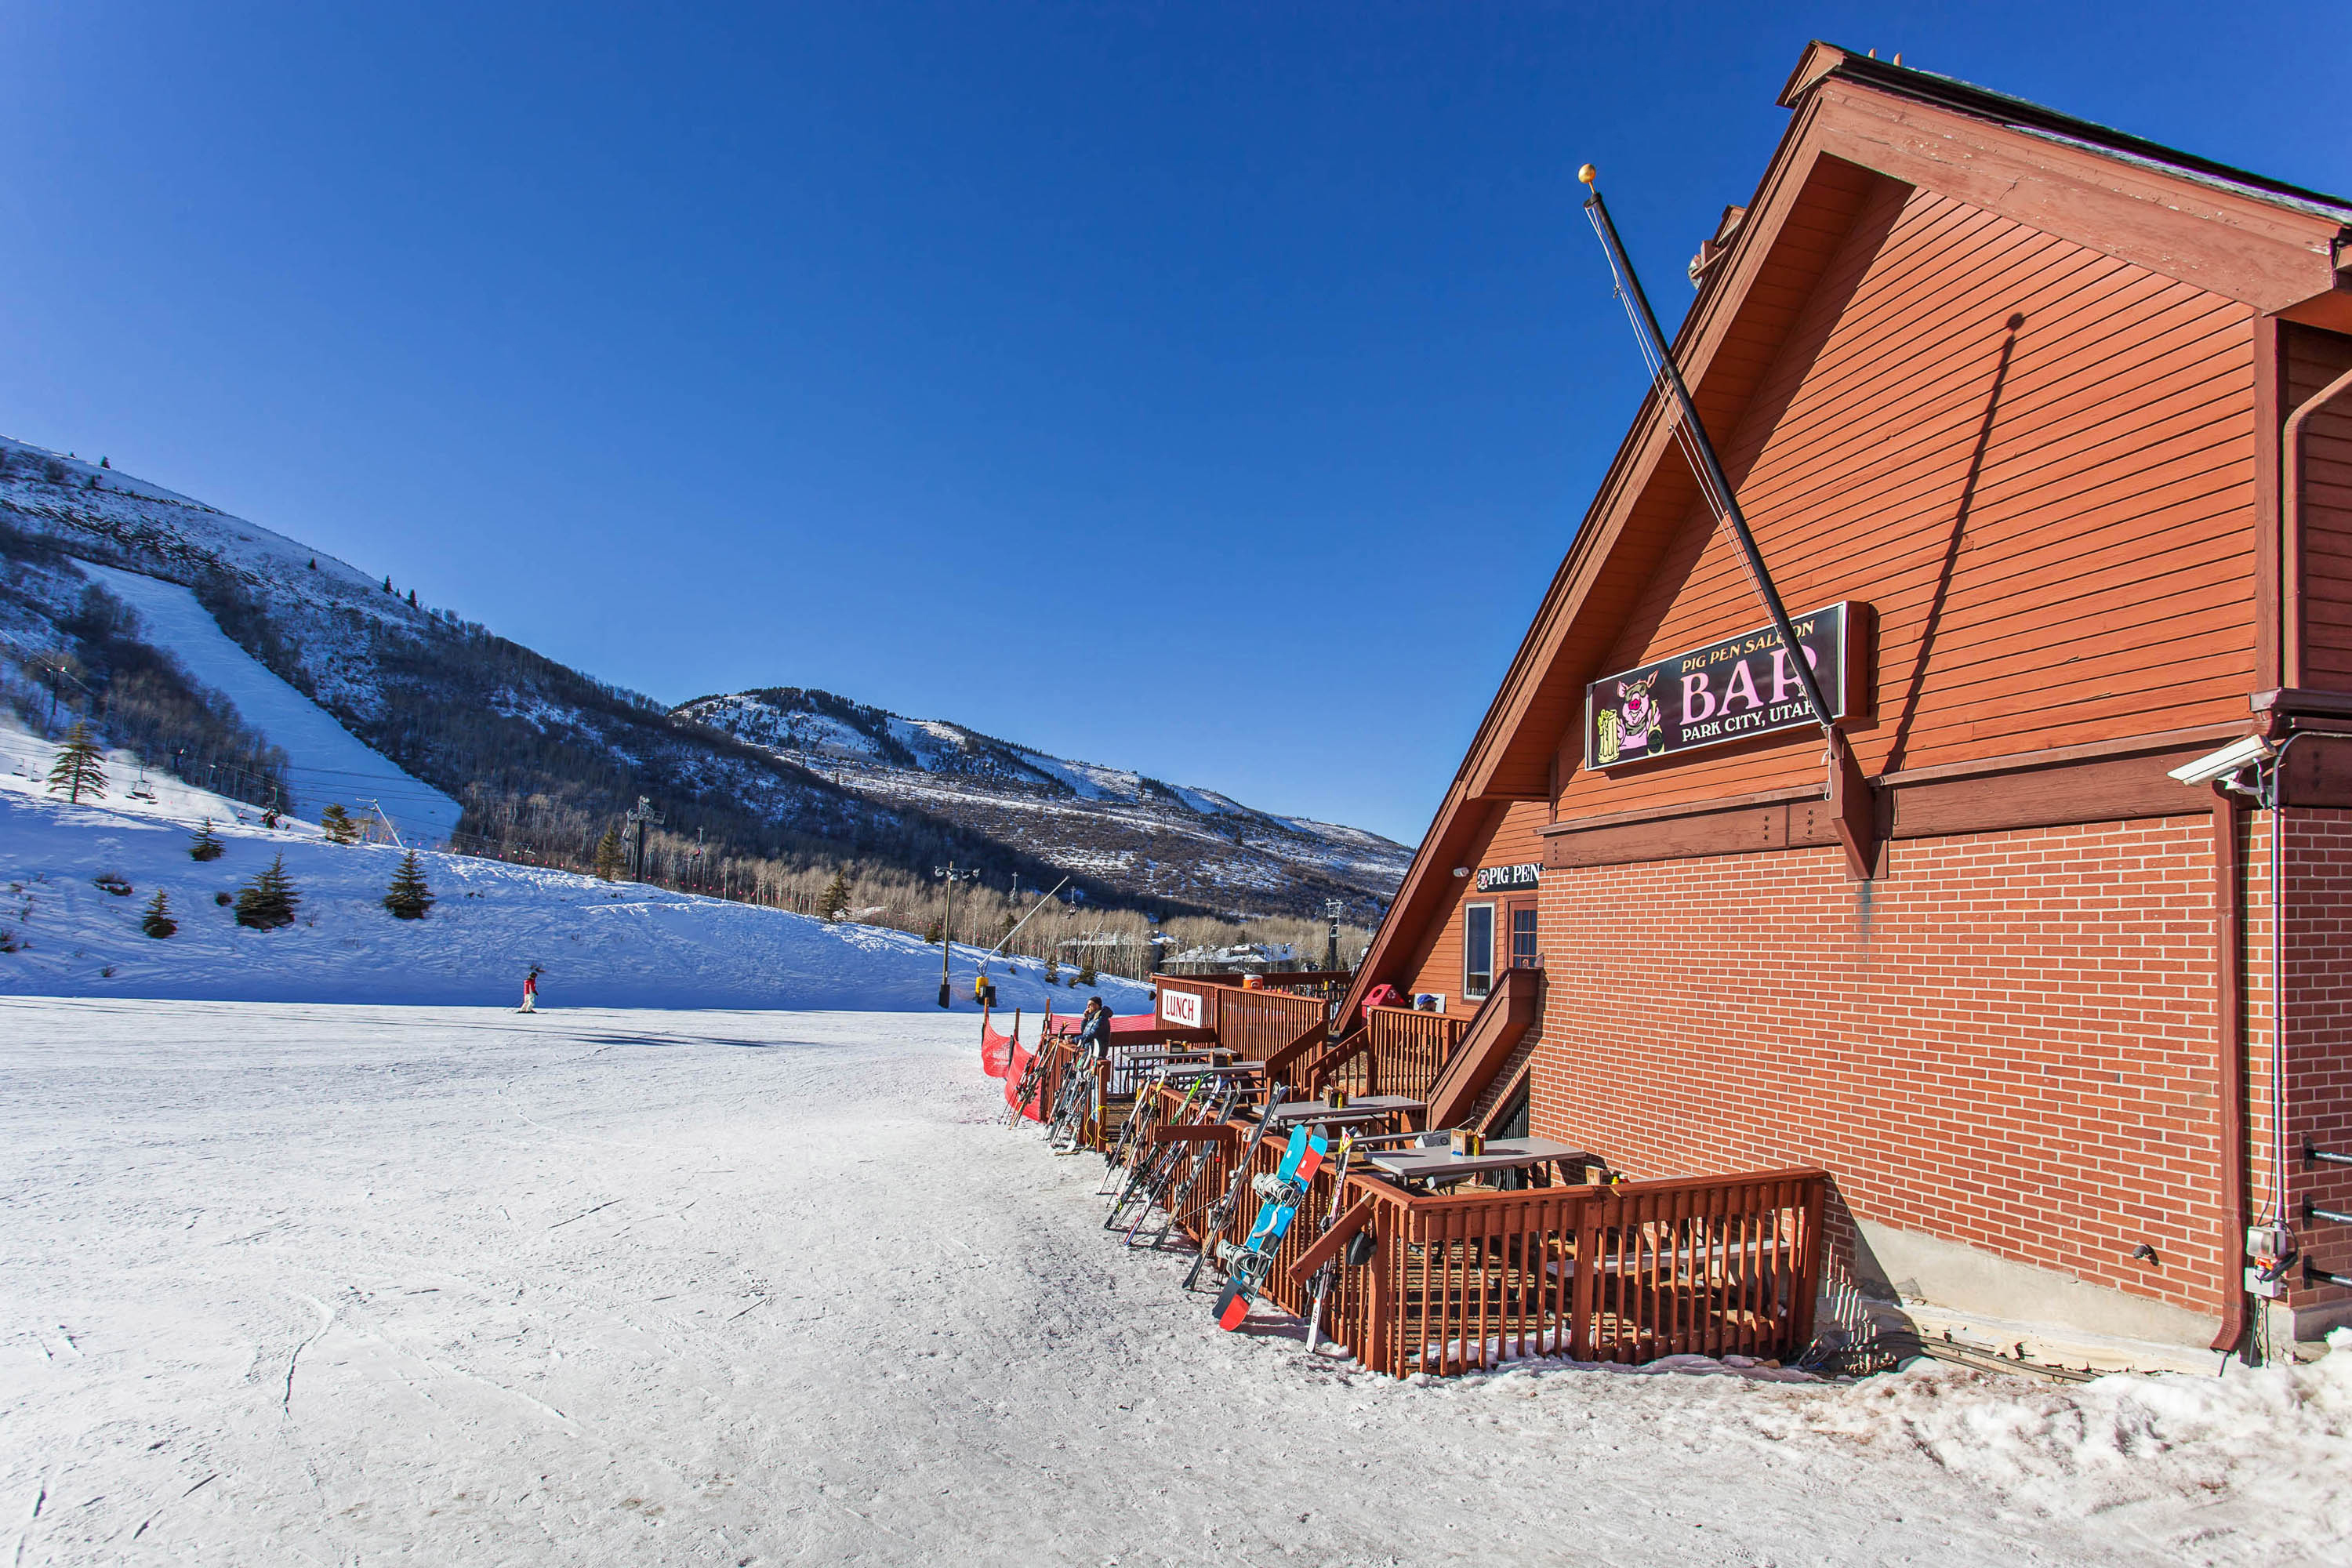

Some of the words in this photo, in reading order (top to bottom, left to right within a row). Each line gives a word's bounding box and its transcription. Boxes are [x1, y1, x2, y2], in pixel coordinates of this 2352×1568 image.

[1682, 656, 1706, 673] PIG
[1710, 644, 1740, 664] PEN
[1679, 644, 1817, 724] BAR
[1682, 722, 1721, 742] PARK
[1724, 711, 1766, 732] CITY,
[1769, 702, 1817, 722] UTAH
[1488, 866, 1509, 885] PIG
[1512, 863, 1541, 883] PEN
[1166, 995, 1194, 1021] LUNCH
